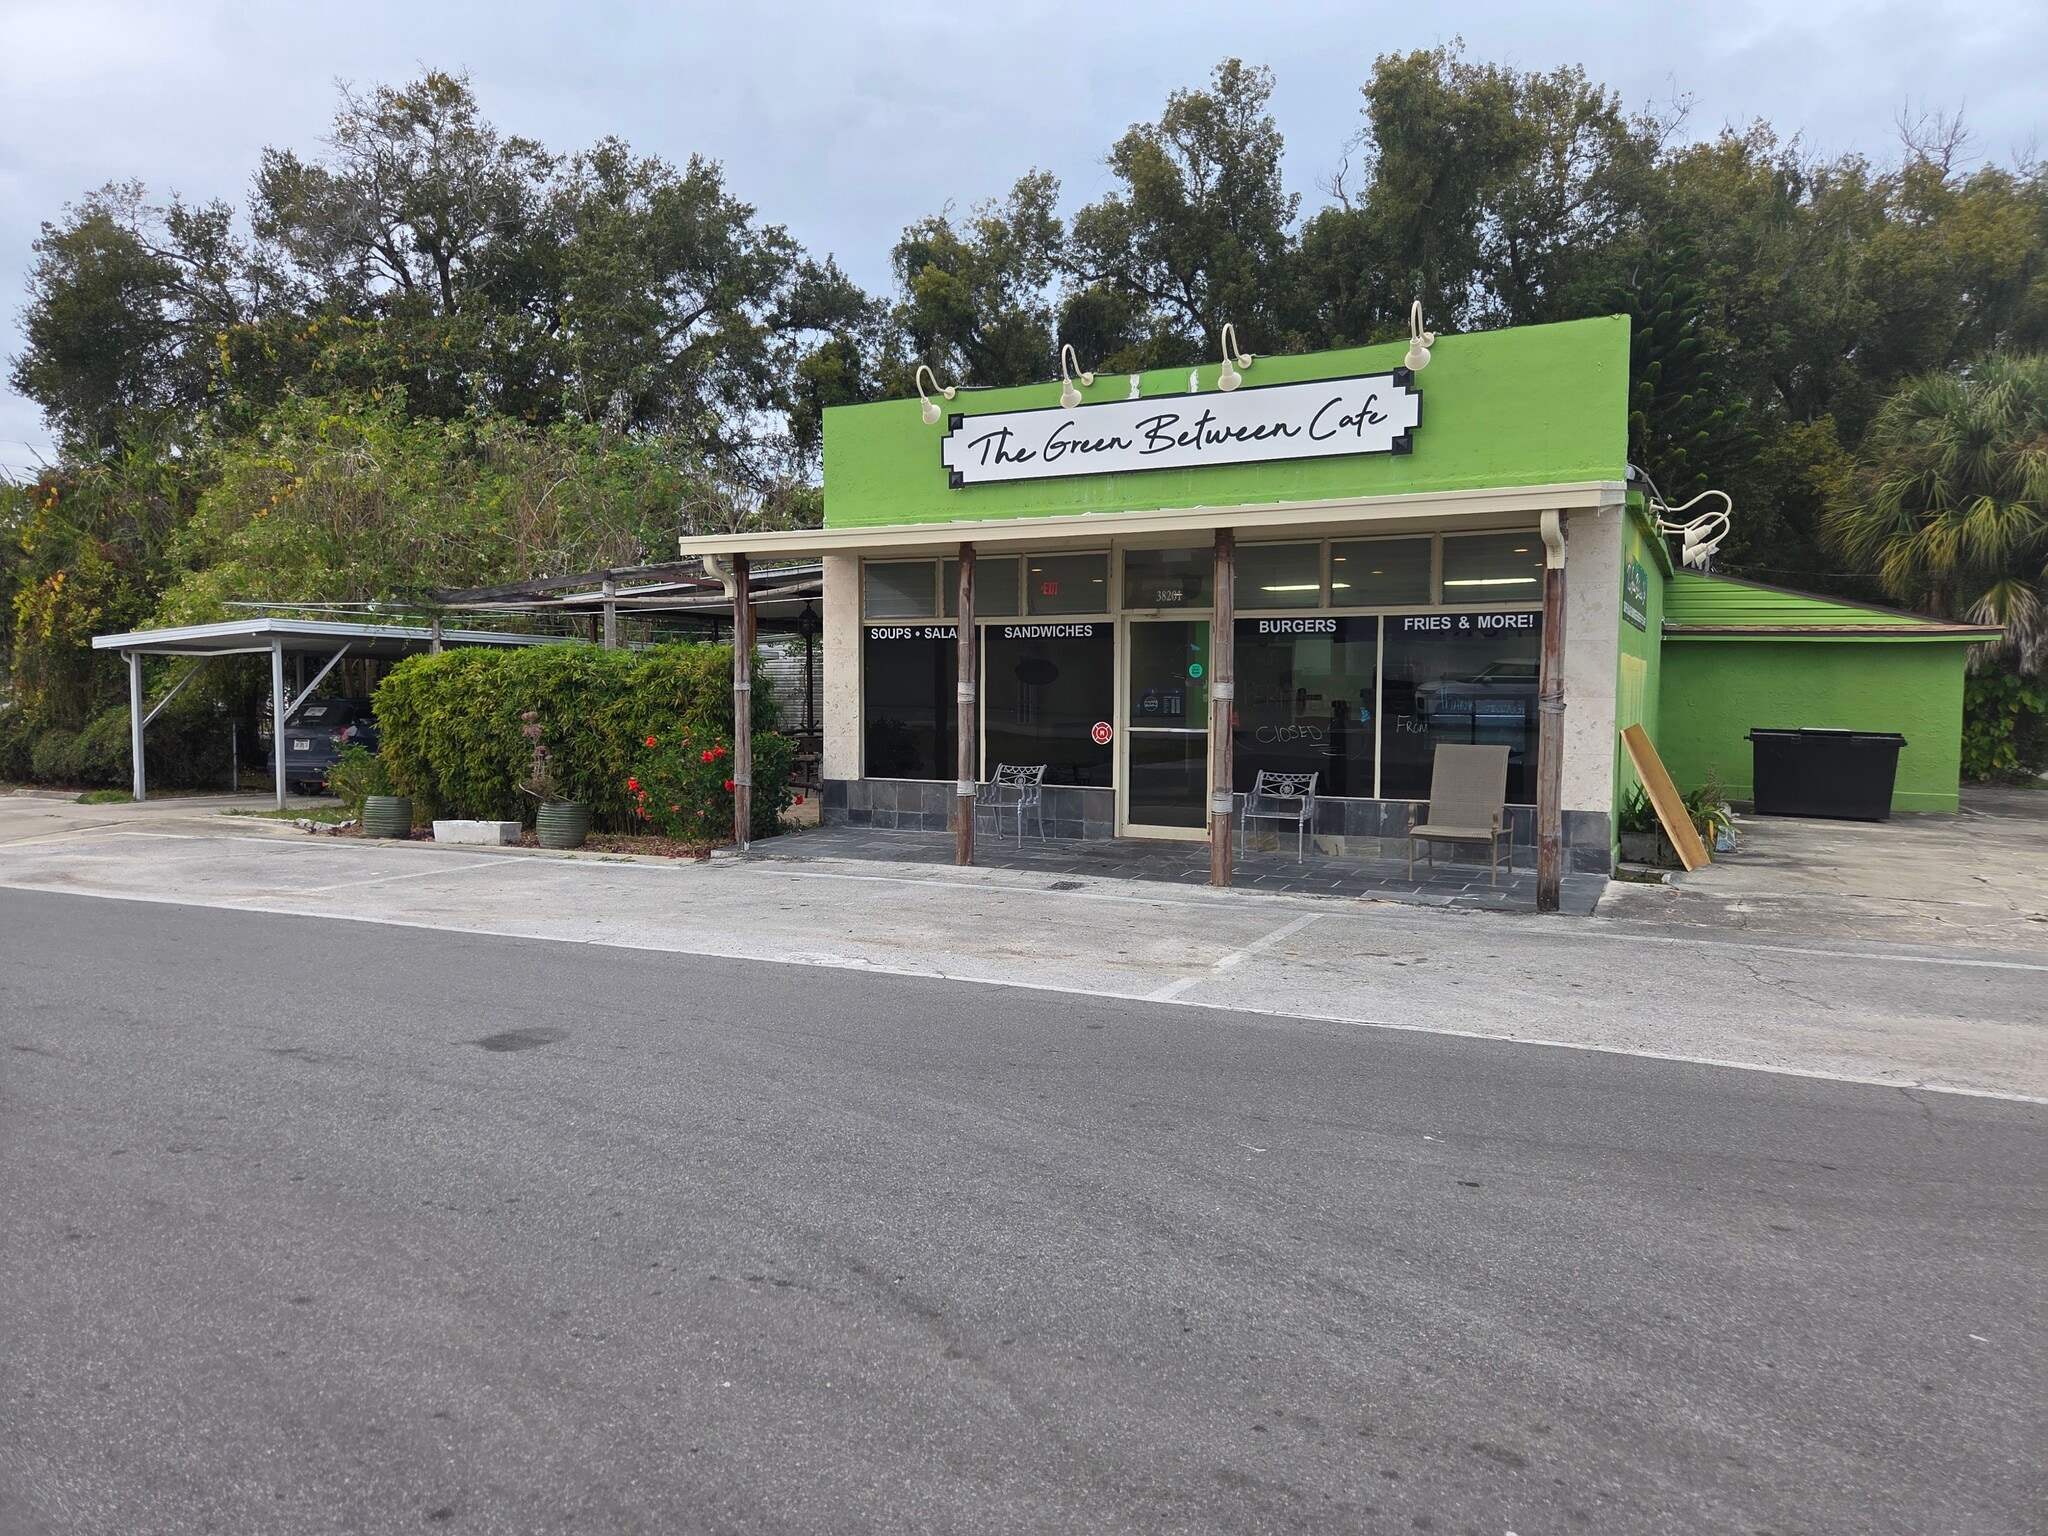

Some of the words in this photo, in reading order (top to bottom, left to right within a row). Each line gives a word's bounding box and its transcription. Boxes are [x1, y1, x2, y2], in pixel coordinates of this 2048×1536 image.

[967, 427, 1037, 466] The
[1043, 421, 1133, 463] Green
[1135, 408, 1302, 455] Between
[1308, 393, 1389, 441] Cafe
[1155, 590, 1182, 602] 38201
[1258, 618, 1337, 634] BURGERS
[1403, 615, 1451, 631] FRIES
[1457, 615, 1471, 630] &
[1477, 614, 1534, 630] MORE!
[870, 627, 912, 640] SOUPS
[924, 627, 957, 640] SALA
[1003, 624, 1093, 639] SANDWICHES
